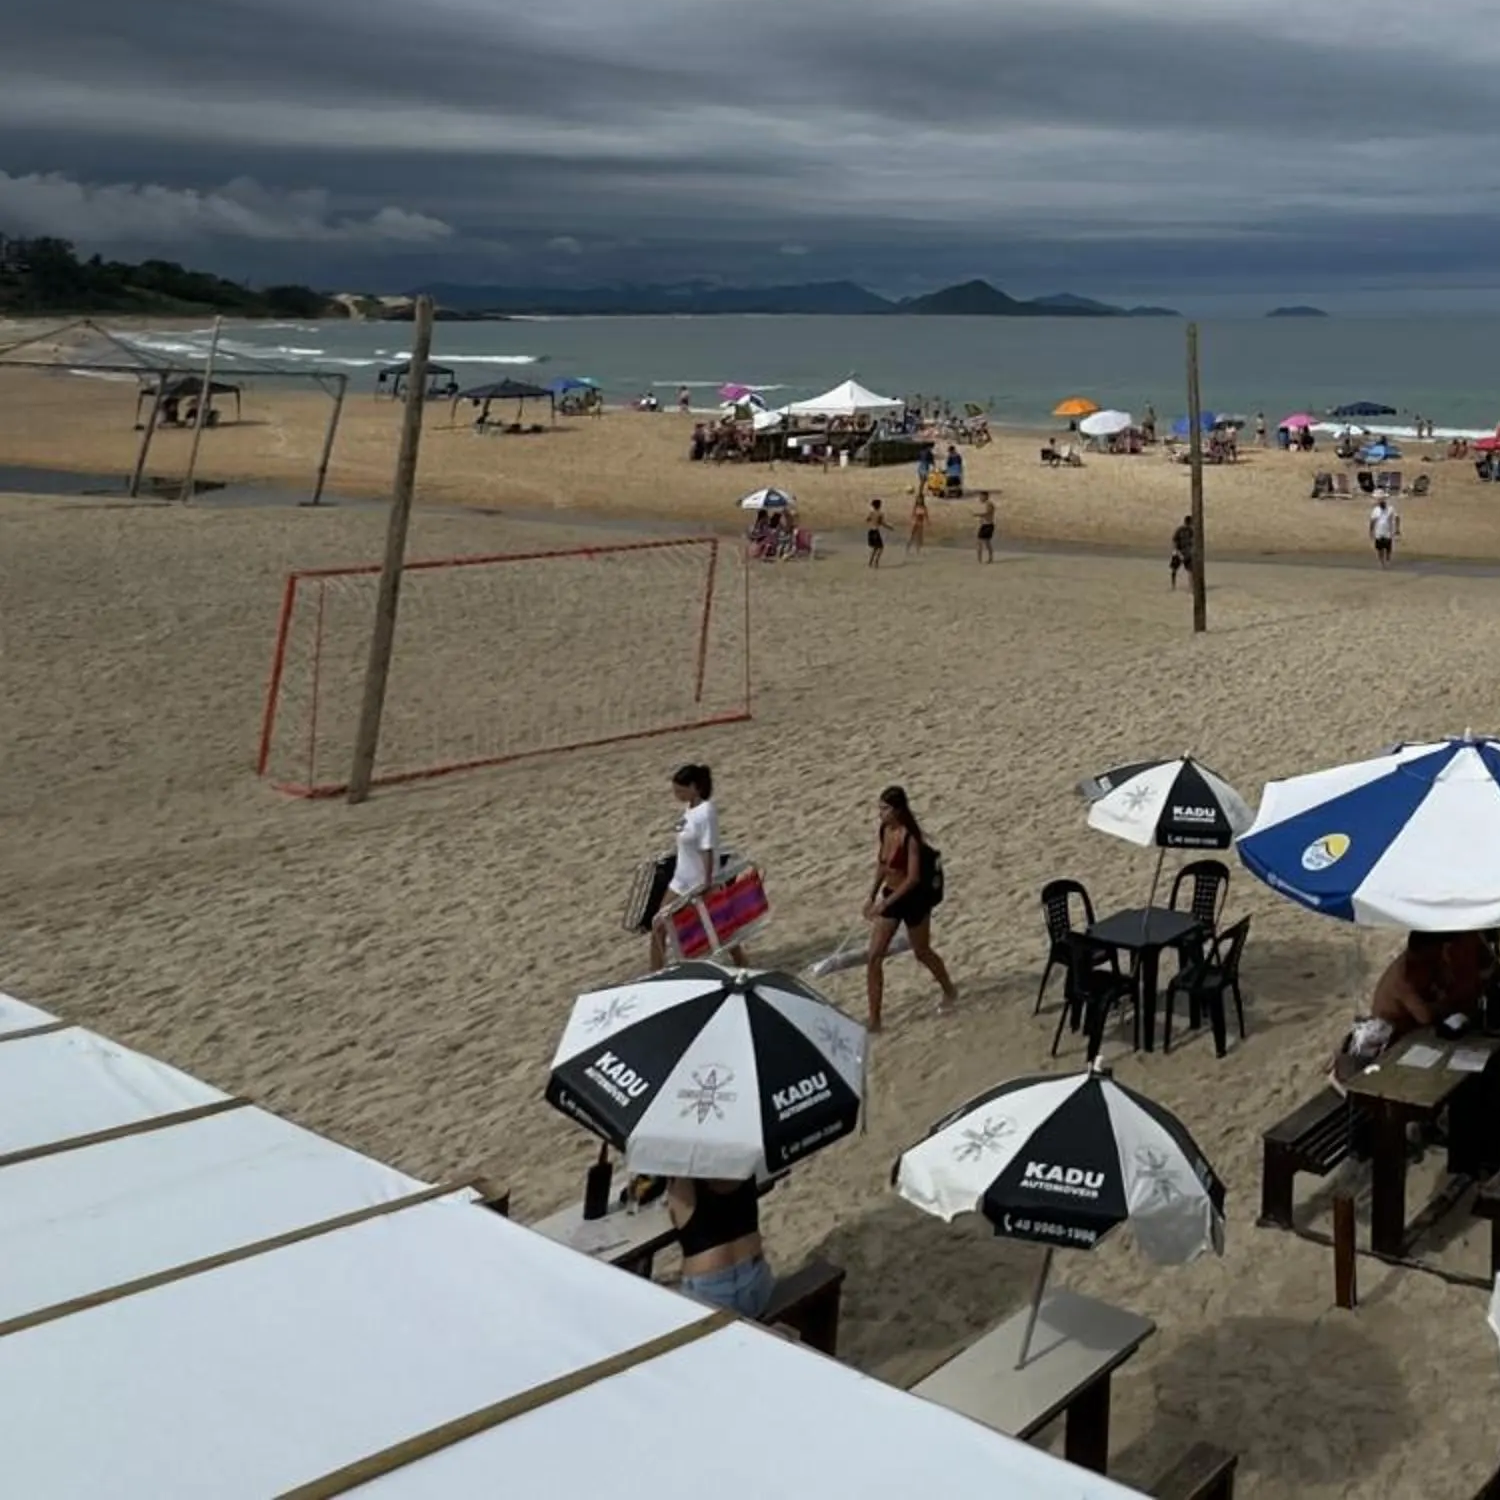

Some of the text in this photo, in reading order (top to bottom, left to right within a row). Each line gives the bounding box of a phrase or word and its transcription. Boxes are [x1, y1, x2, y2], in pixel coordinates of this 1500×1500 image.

[1173, 806, 1216, 817] KADU
[594, 1051, 650, 1097] KADU
[772, 1072, 828, 1111] KADU
[1024, 1161, 1105, 1188] KADU
